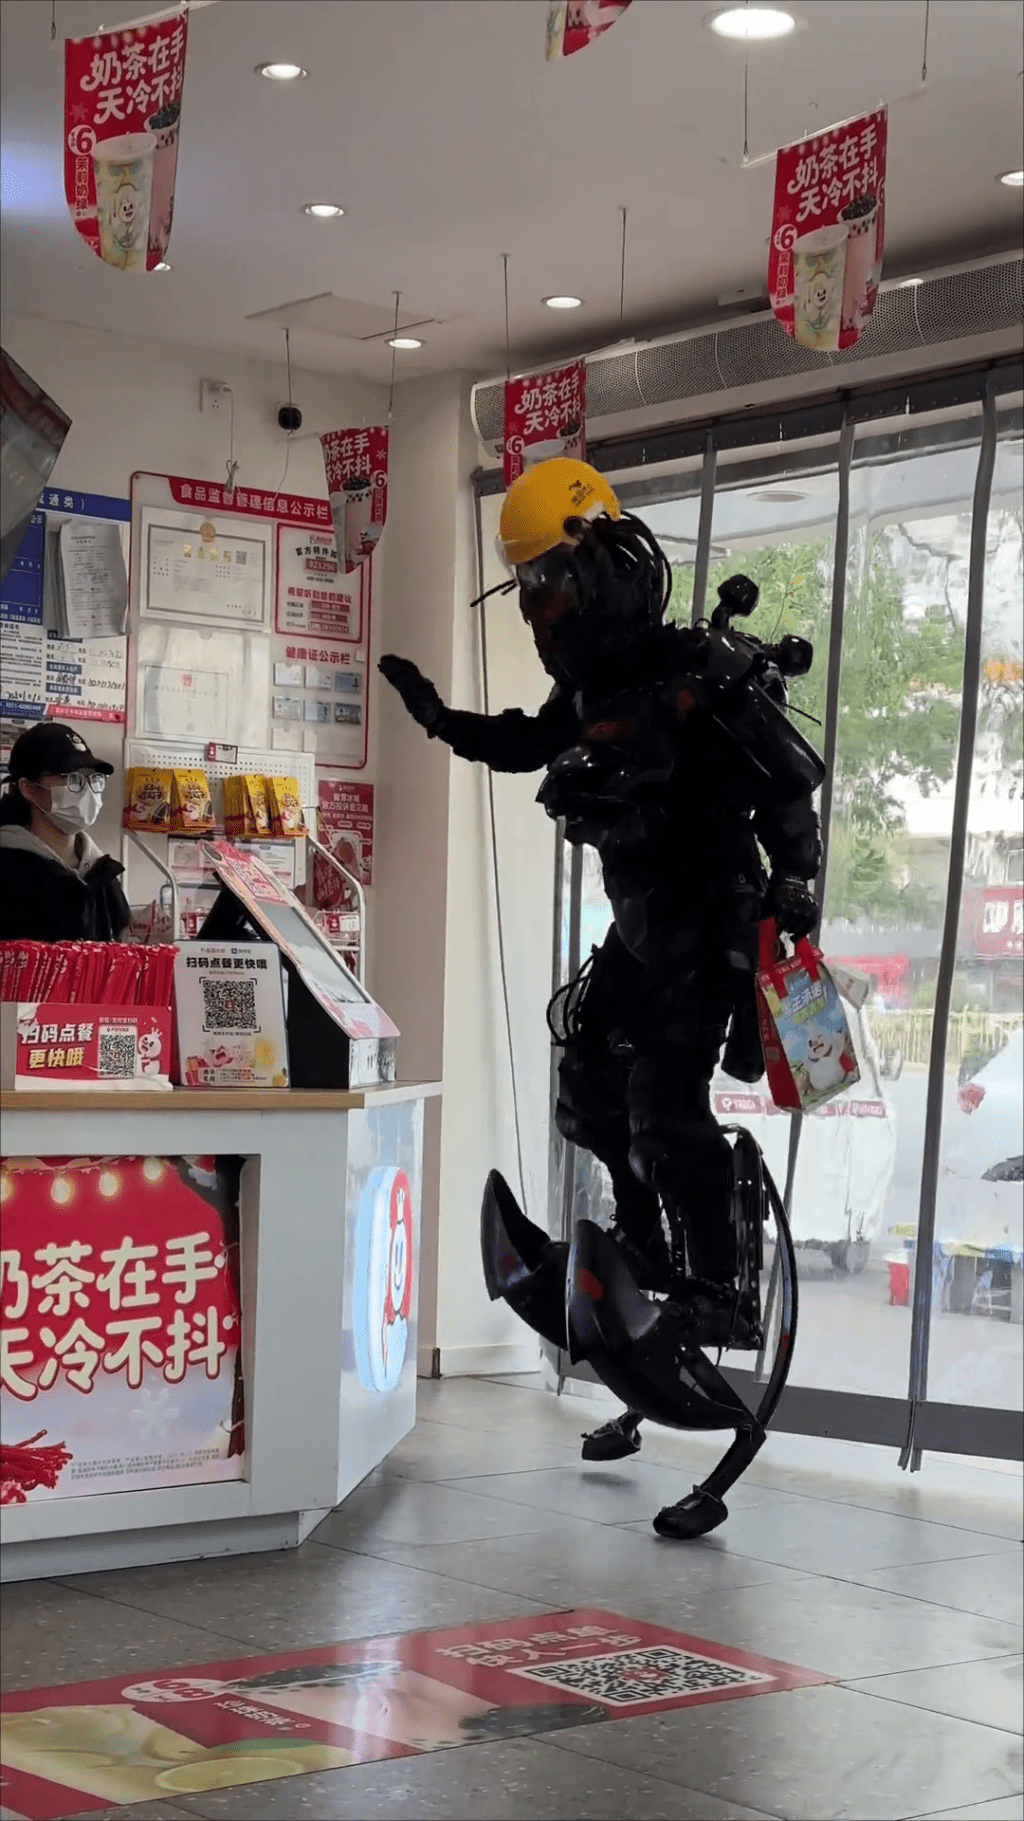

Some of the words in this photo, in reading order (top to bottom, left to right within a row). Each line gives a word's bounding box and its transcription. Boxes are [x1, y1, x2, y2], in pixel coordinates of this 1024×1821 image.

[80, 25, 184, 91] 奶茶在手
[76, 127, 93, 154] 6
[787, 124, 877, 194] 奶茶在手
[796, 157, 877, 222] 天冷不抖
[780, 227, 794, 250] 6
[515, 371, 580, 414] 奶茶在手
[512, 438, 523, 453] 6
[375, 472, 385, 487] 6
[180, 484, 329, 519] 食品监督管理信息公示栏
[286, 646, 350, 665] 健康证公示栏
[186, 956, 268, 971] 扫码点餐更快哦
[20, 1023, 94, 1045] 扫码点餐
[28, 1047, 85, 1069] 更快哦
[434, 1625, 618, 1658] 扫码点单
[466, 1634, 642, 1667] 快人一步
